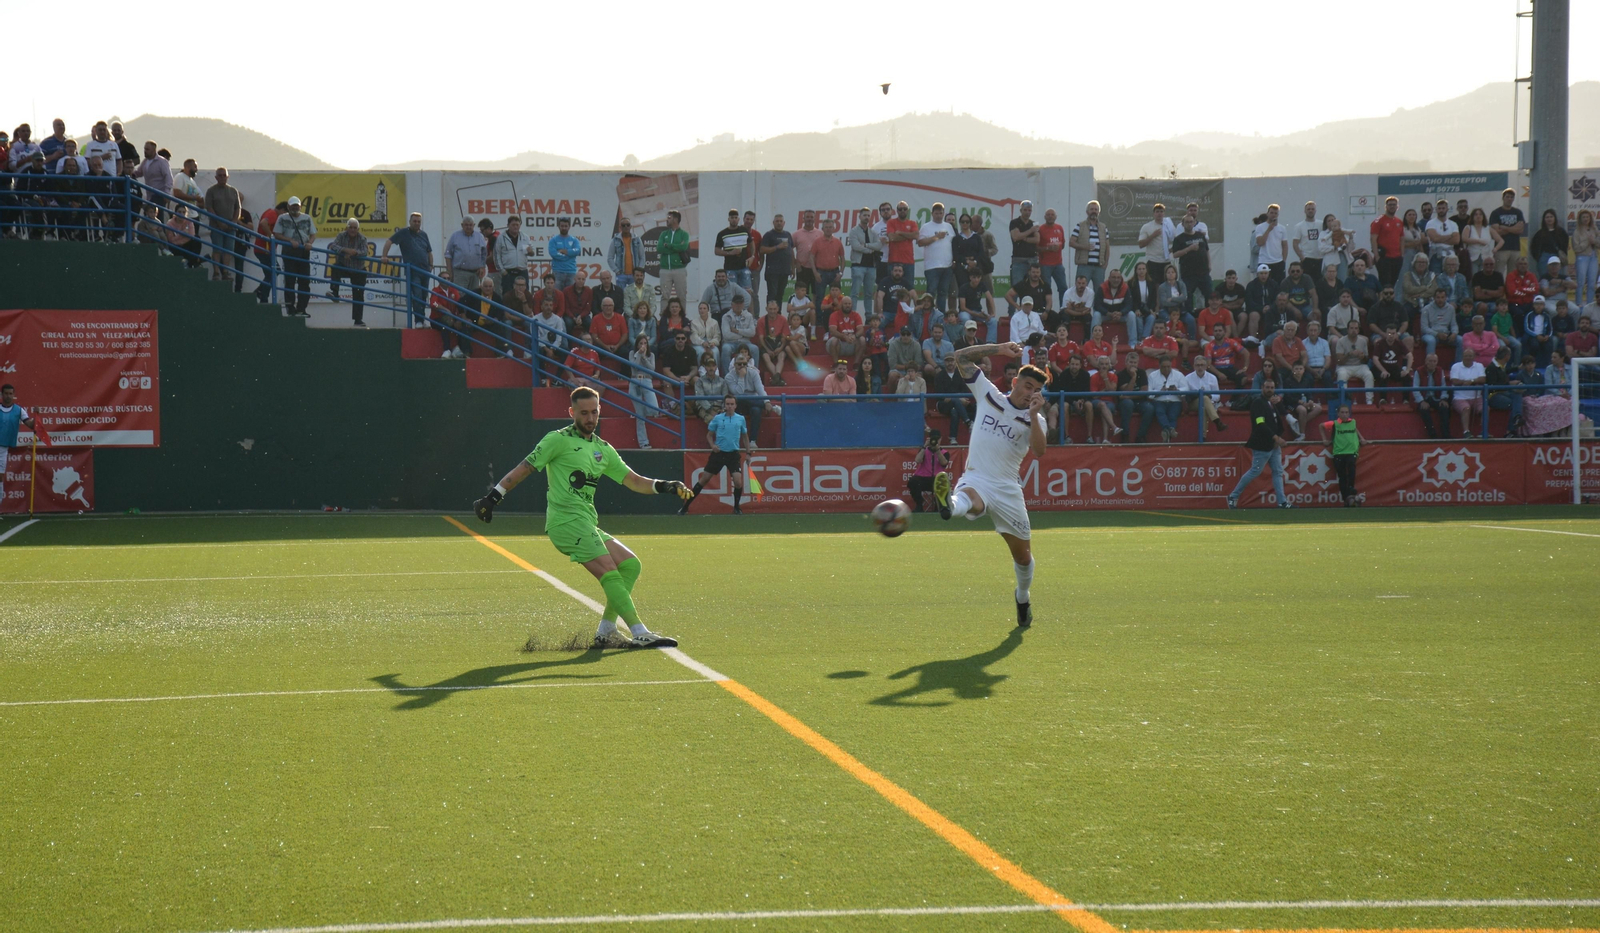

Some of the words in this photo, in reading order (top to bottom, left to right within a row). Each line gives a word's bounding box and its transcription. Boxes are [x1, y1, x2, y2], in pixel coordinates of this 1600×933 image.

[1399, 178, 1442, 186] DESPACHO
[1444, 176, 1487, 184] RECEPTOR
[468, 199, 590, 214] BERAMAR
[526, 217, 591, 227] COCIAS
[60, 405, 113, 413] DECORATIVAS
[115, 404, 153, 413] RÚSTICAS
[42, 417, 53, 425] DE
[56, 416, 83, 424] BARRO
[84, 416, 117, 424] COCIDO
[1532, 446, 1600, 465] ACADE
[902, 461, 917, 470] 952
[6, 471, 32, 482] Ruiz
[1166, 466, 1188, 478] 687
[1191, 466, 1206, 478] 76
[1208, 466, 1220, 478] 51
[1224, 466, 1237, 478] 51
[8, 490, 25, 498] 250
[788, 493, 845, 503] FABRICACIÓN
[853, 493, 887, 502] LACADO
[1042, 498, 1051, 506] de
[1052, 498, 1083, 507] Limpieza
[1090, 497, 1145, 506] Mantenimiento
[1164, 482, 1187, 492] Torre
[1189, 482, 1204, 492] del
[1205, 482, 1224, 492] Mar
[1258, 491, 1313, 504] Tooso
[1396, 489, 1452, 502] Toboso
[1456, 489, 1506, 502] Hotels
